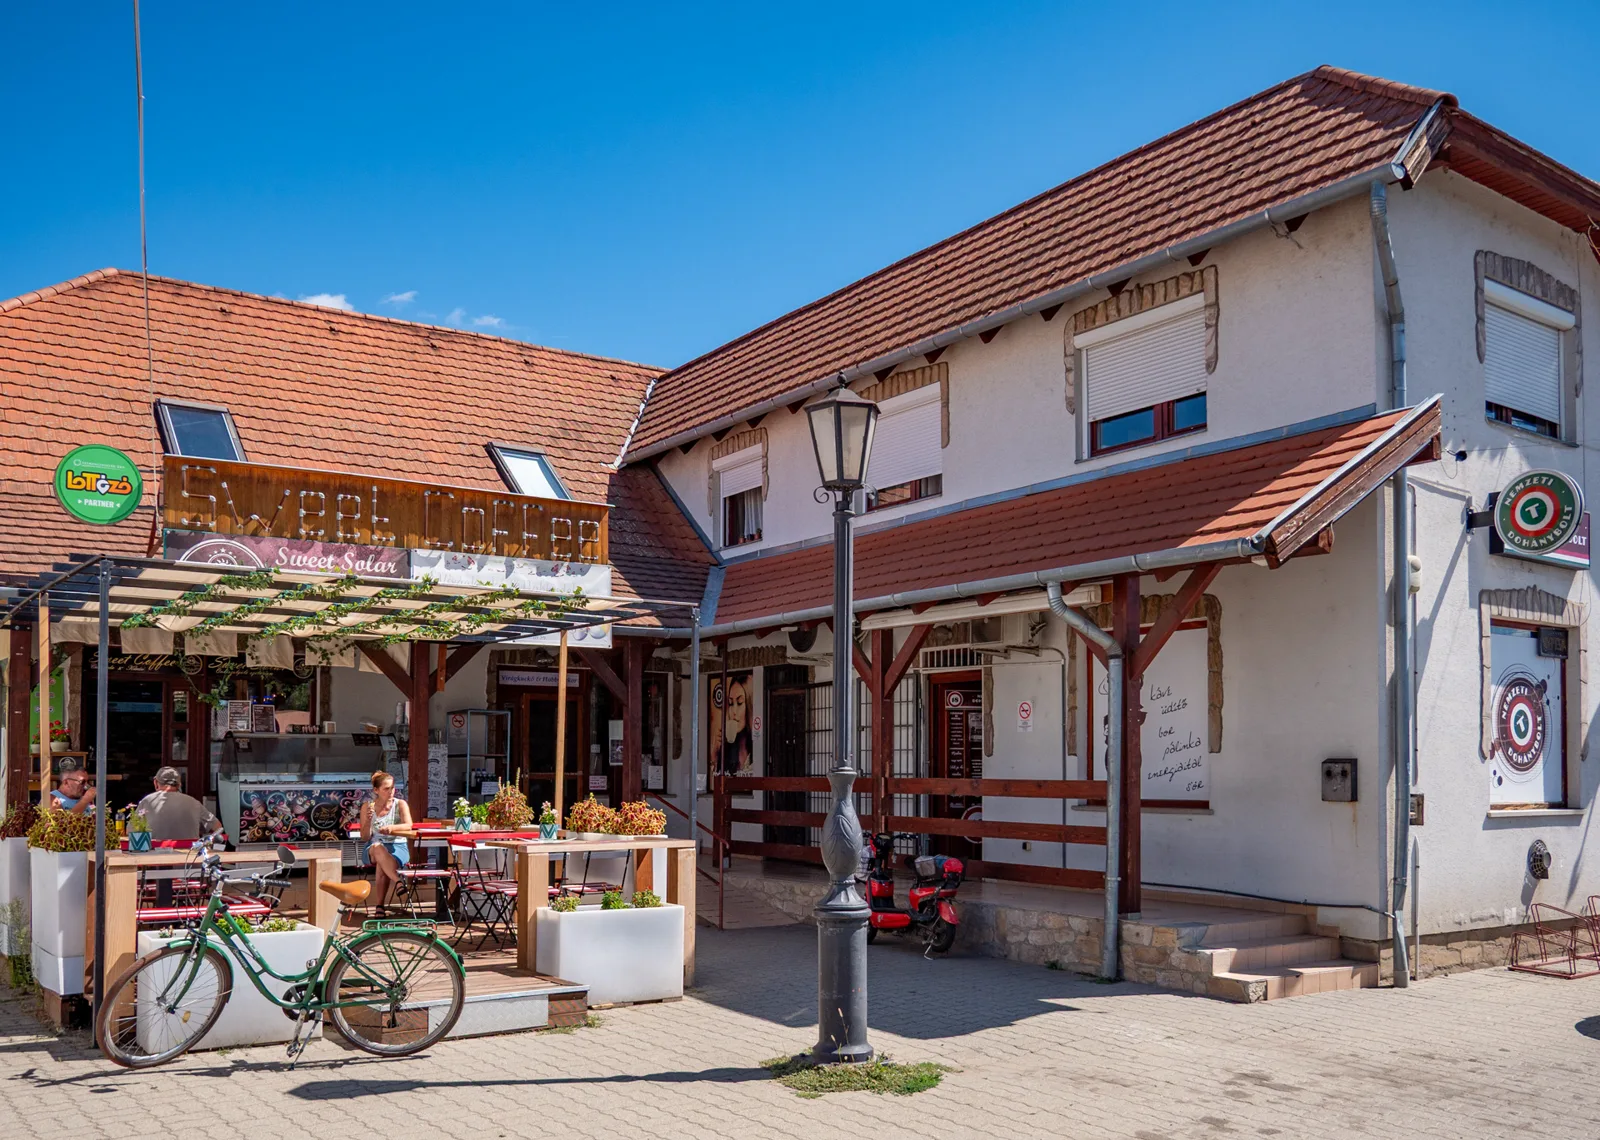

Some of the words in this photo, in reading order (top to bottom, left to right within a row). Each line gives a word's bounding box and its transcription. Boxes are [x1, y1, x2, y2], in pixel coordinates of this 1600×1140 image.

[84, 499, 115, 508] PARTNER
[1504, 476, 1554, 506] NEMZETI
[1525, 503, 1540, 519] T
[1507, 505, 1573, 548] DOHÁNYBOLT
[275, 546, 337, 571] Sweet
[340, 552, 397, 574] Solar
[134, 653, 177, 671] Coffee
[1501, 684, 1530, 720] NEMZETI
[1516, 716, 1527, 733] T
[1507, 715, 1543, 764] DOHÁNYBOLT
